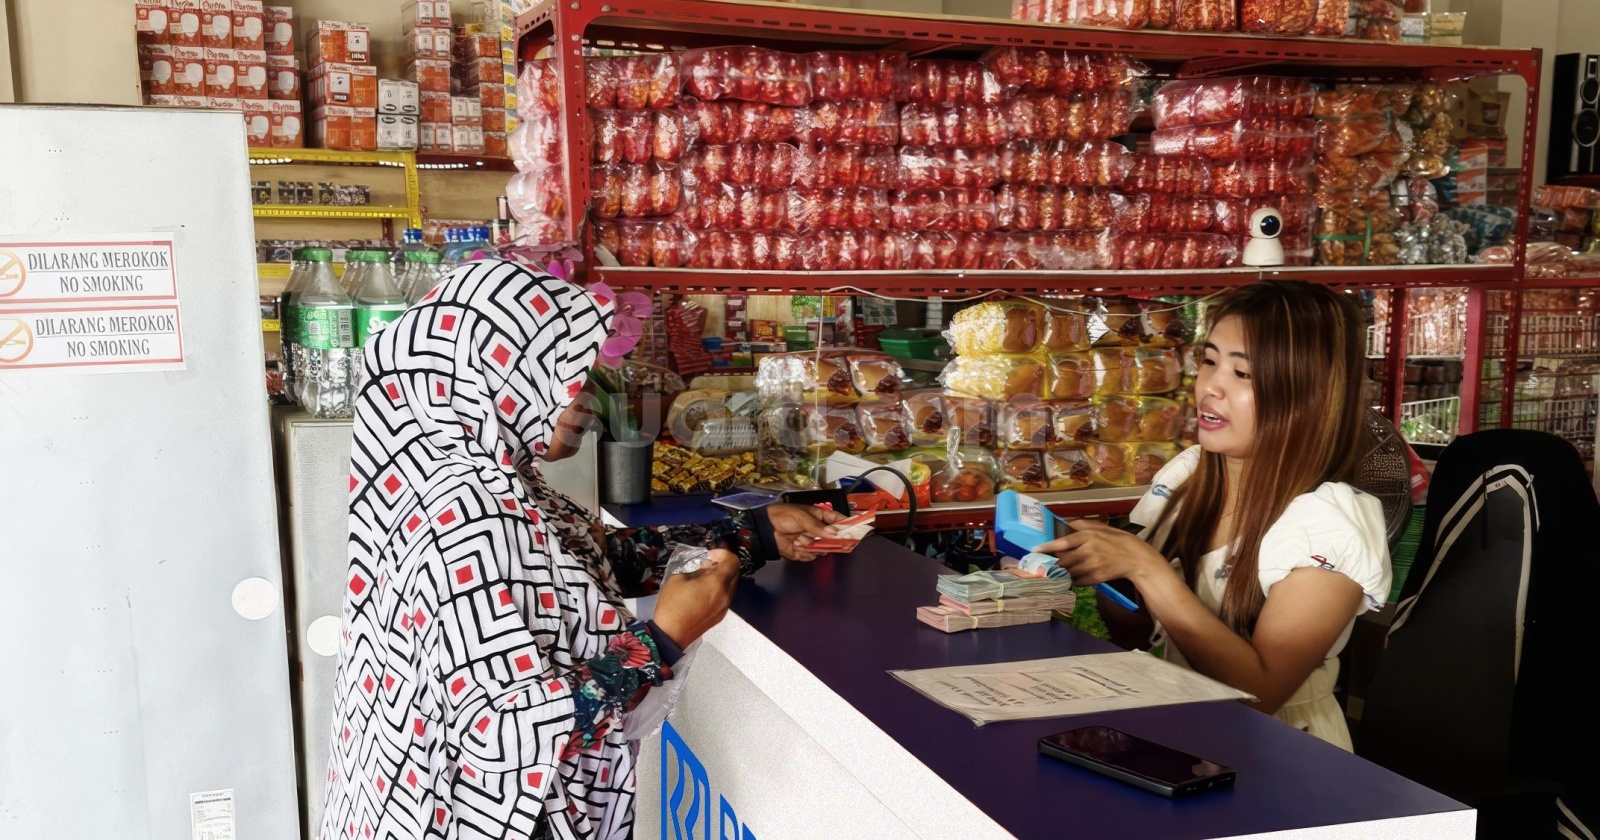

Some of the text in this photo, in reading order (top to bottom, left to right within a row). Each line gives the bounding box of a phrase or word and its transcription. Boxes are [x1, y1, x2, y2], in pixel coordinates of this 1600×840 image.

[28, 251, 169, 270] DILARANG MEROKOK
[60, 275, 143, 293] NO SMOKING
[35, 315, 175, 336] DILARANG MEROKOK
[67, 338, 150, 358] NO SMOKING
